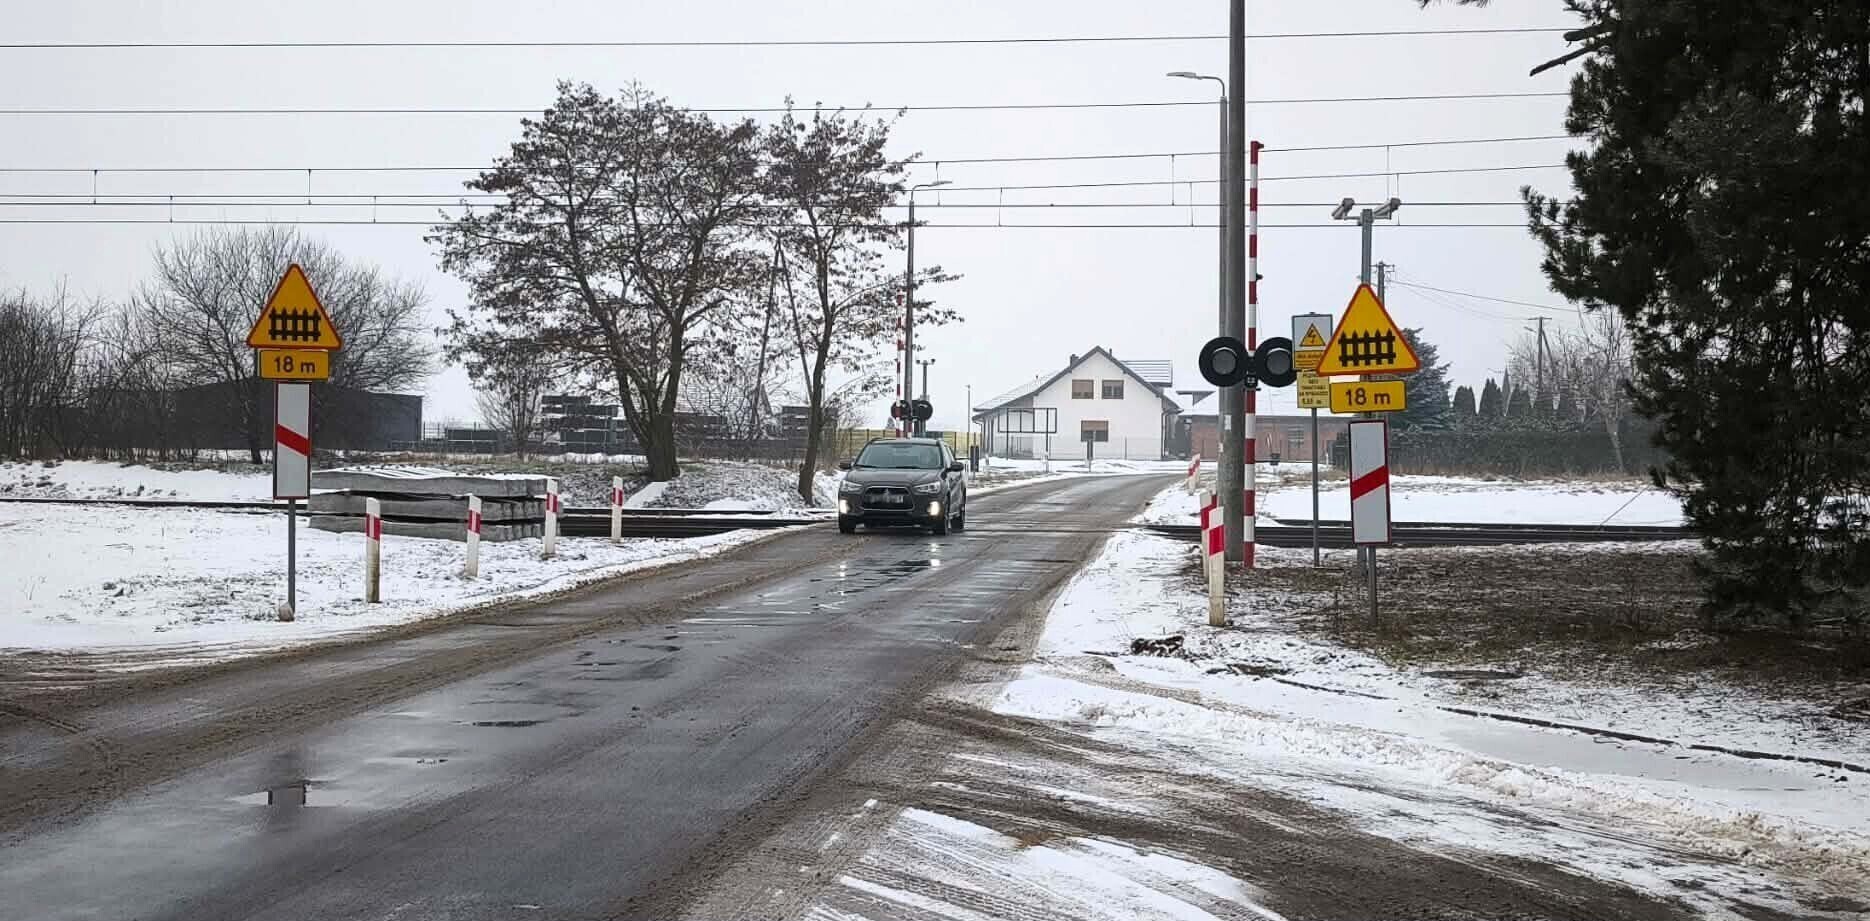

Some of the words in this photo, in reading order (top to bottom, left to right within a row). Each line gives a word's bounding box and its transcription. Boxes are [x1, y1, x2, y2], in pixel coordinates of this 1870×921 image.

[274, 355, 294, 373] 18
[300, 361, 316, 373] m
[1345, 387, 1367, 406] 18
[1373, 392, 1391, 405] m
